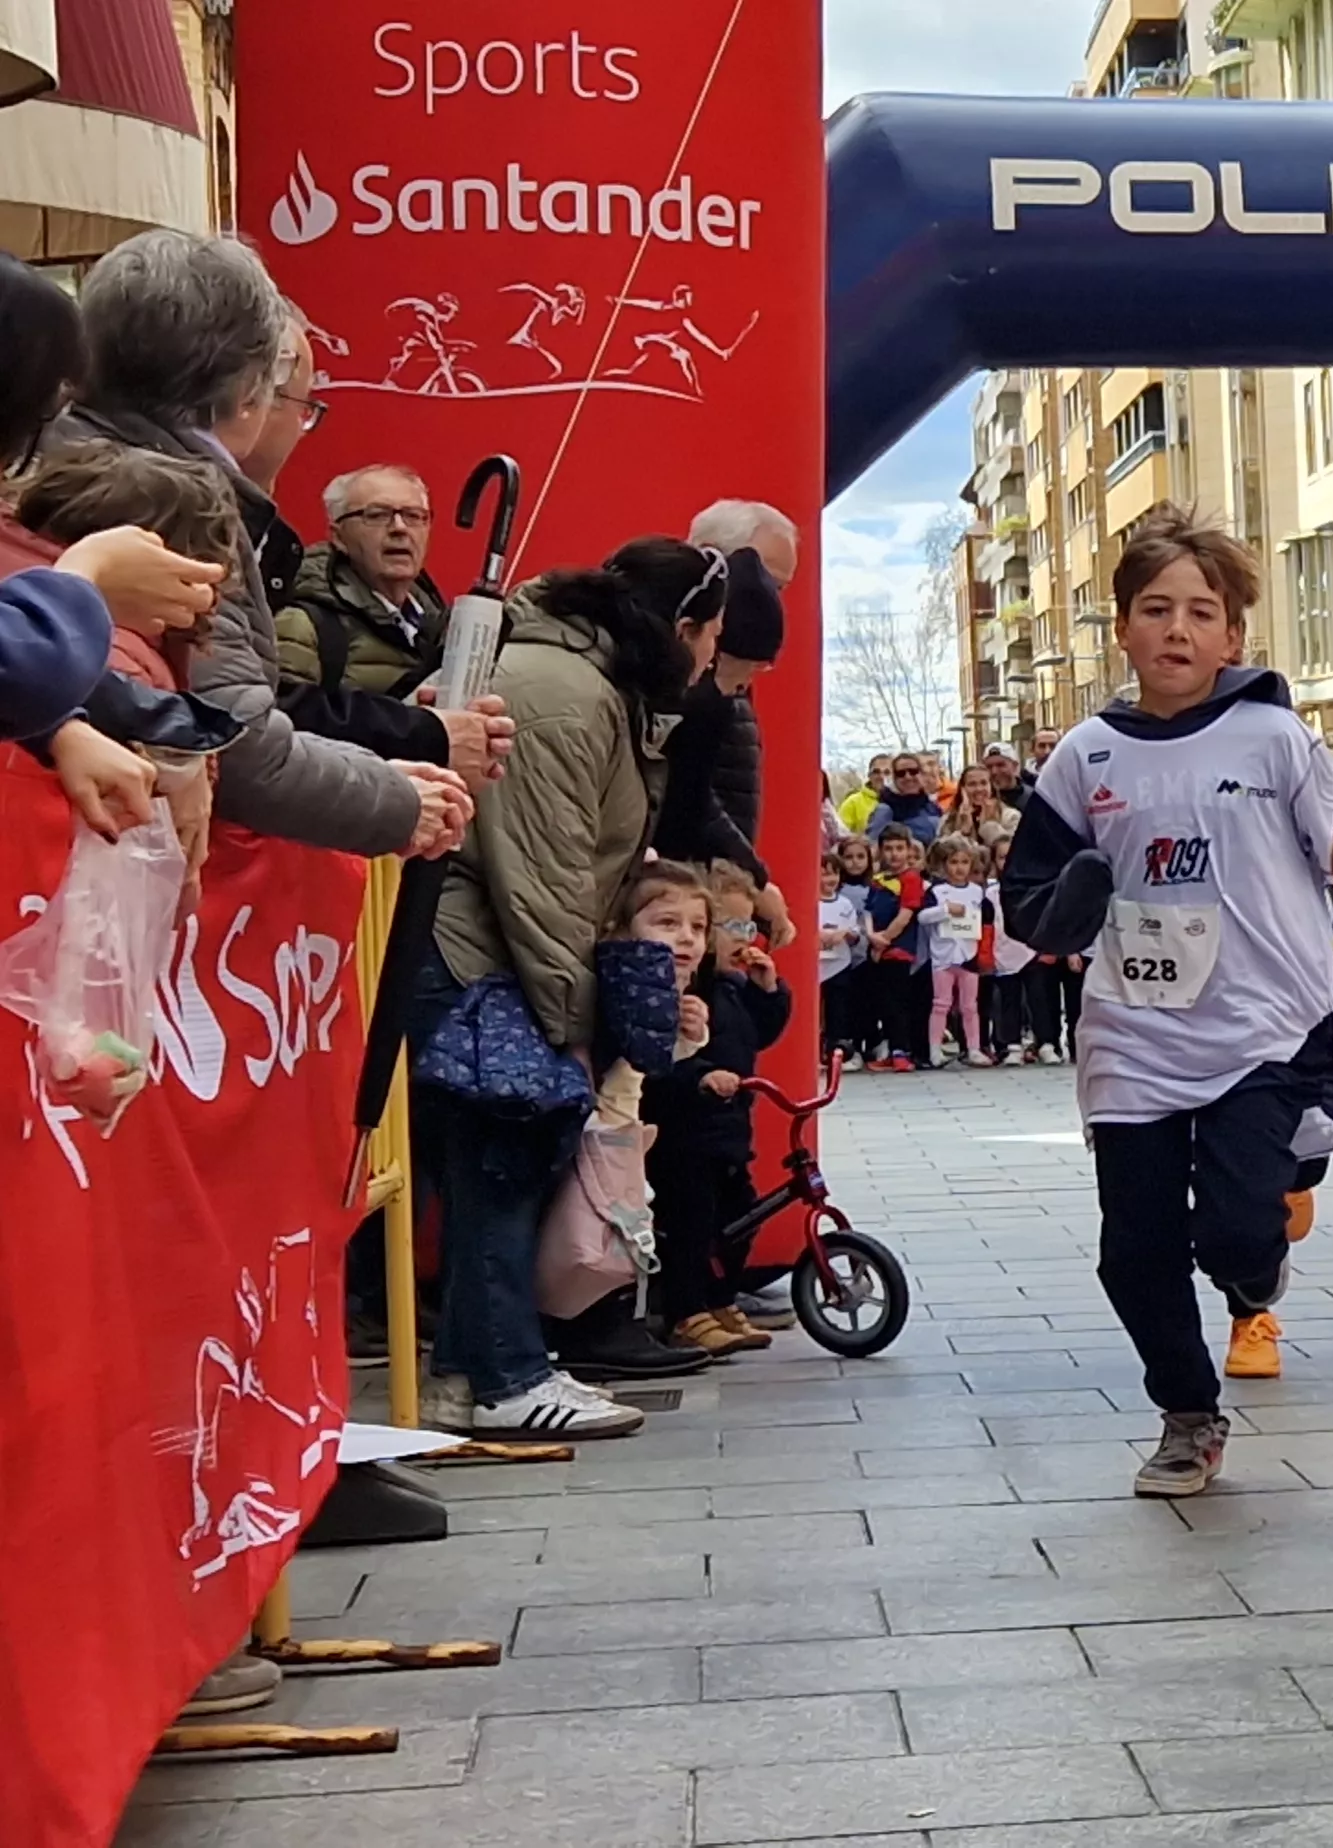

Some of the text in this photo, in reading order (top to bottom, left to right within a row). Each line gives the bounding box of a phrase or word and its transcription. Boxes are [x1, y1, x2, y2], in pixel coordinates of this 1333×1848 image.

[373, 22, 641, 115] Sports
[351, 163, 761, 250] Santander
[1123, 957, 1178, 982] 628
